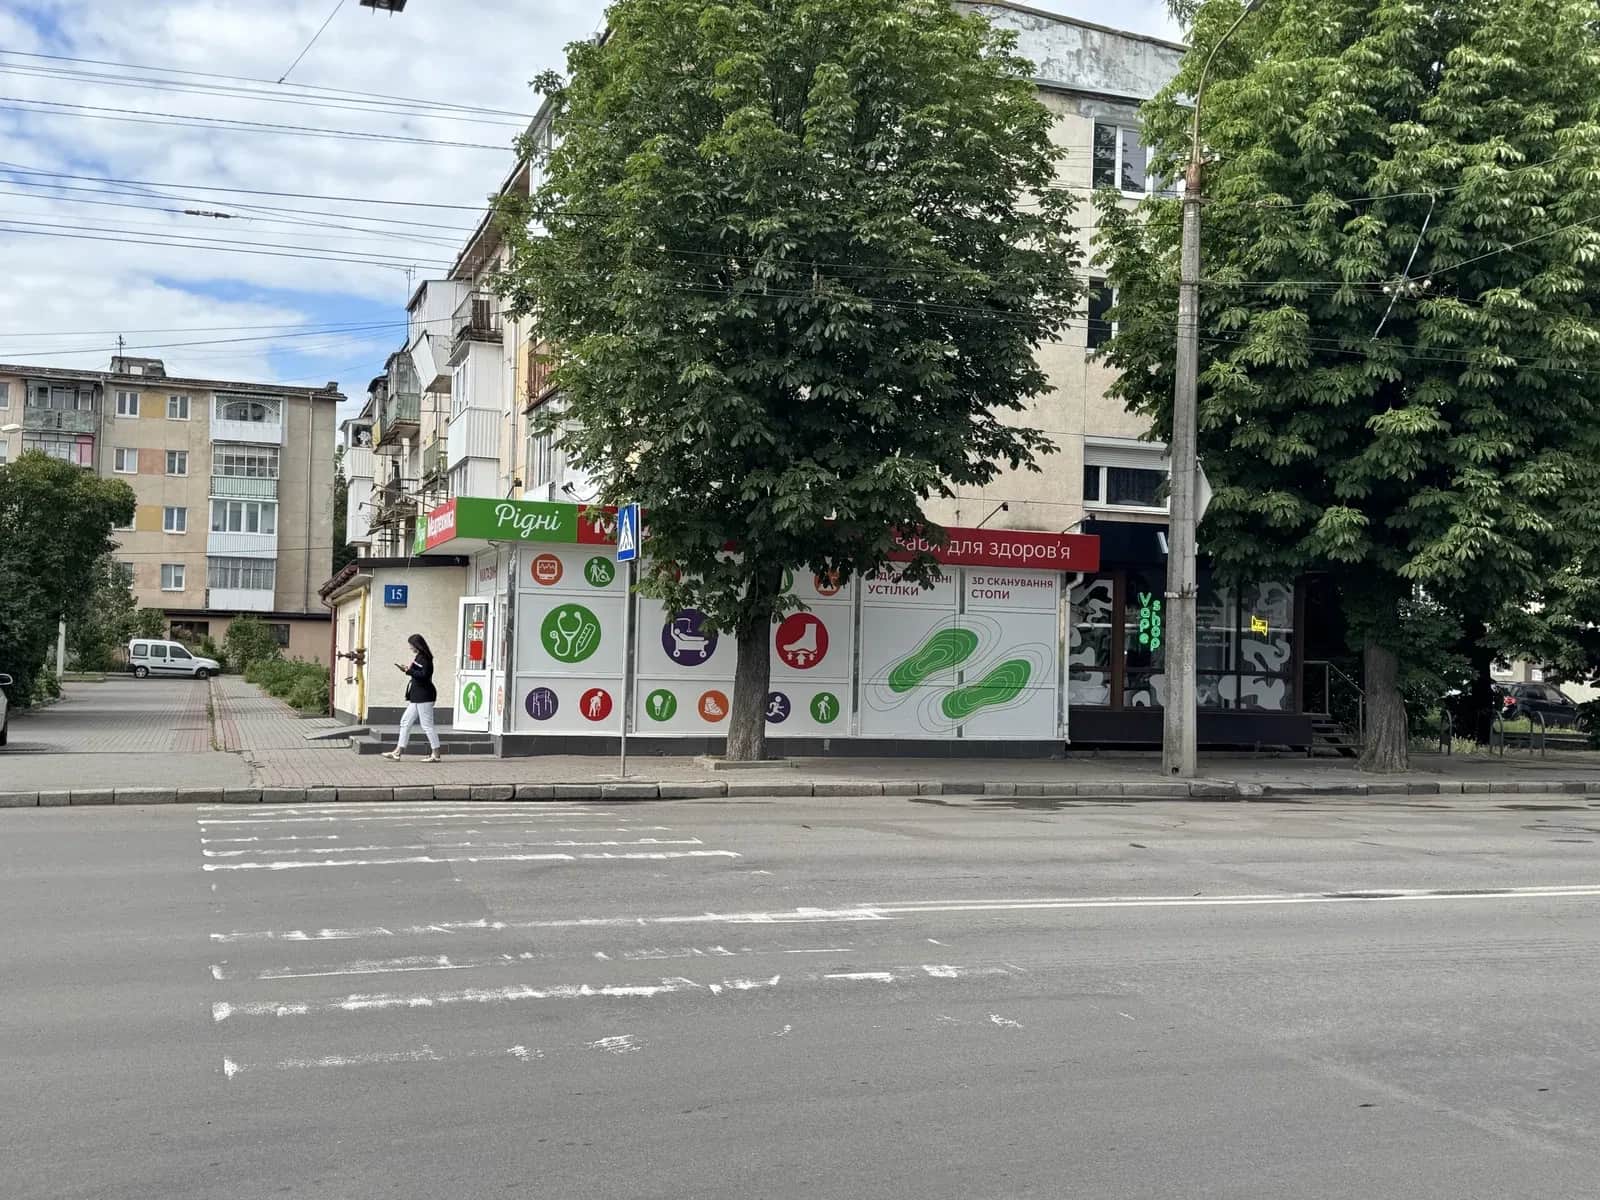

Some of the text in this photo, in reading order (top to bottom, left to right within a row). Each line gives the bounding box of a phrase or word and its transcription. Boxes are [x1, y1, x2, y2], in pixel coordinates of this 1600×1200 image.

[495, 503, 562, 538] Рідні
[947, 540, 983, 556] для
[989, 541, 1071, 562] здоров'я
[971, 577, 1053, 588] 3D СКАНУВАННЯ
[391, 588, 402, 600] 15
[868, 584, 919, 596] УСТІЛКИ
[971, 589, 1010, 599] СТОПИ
